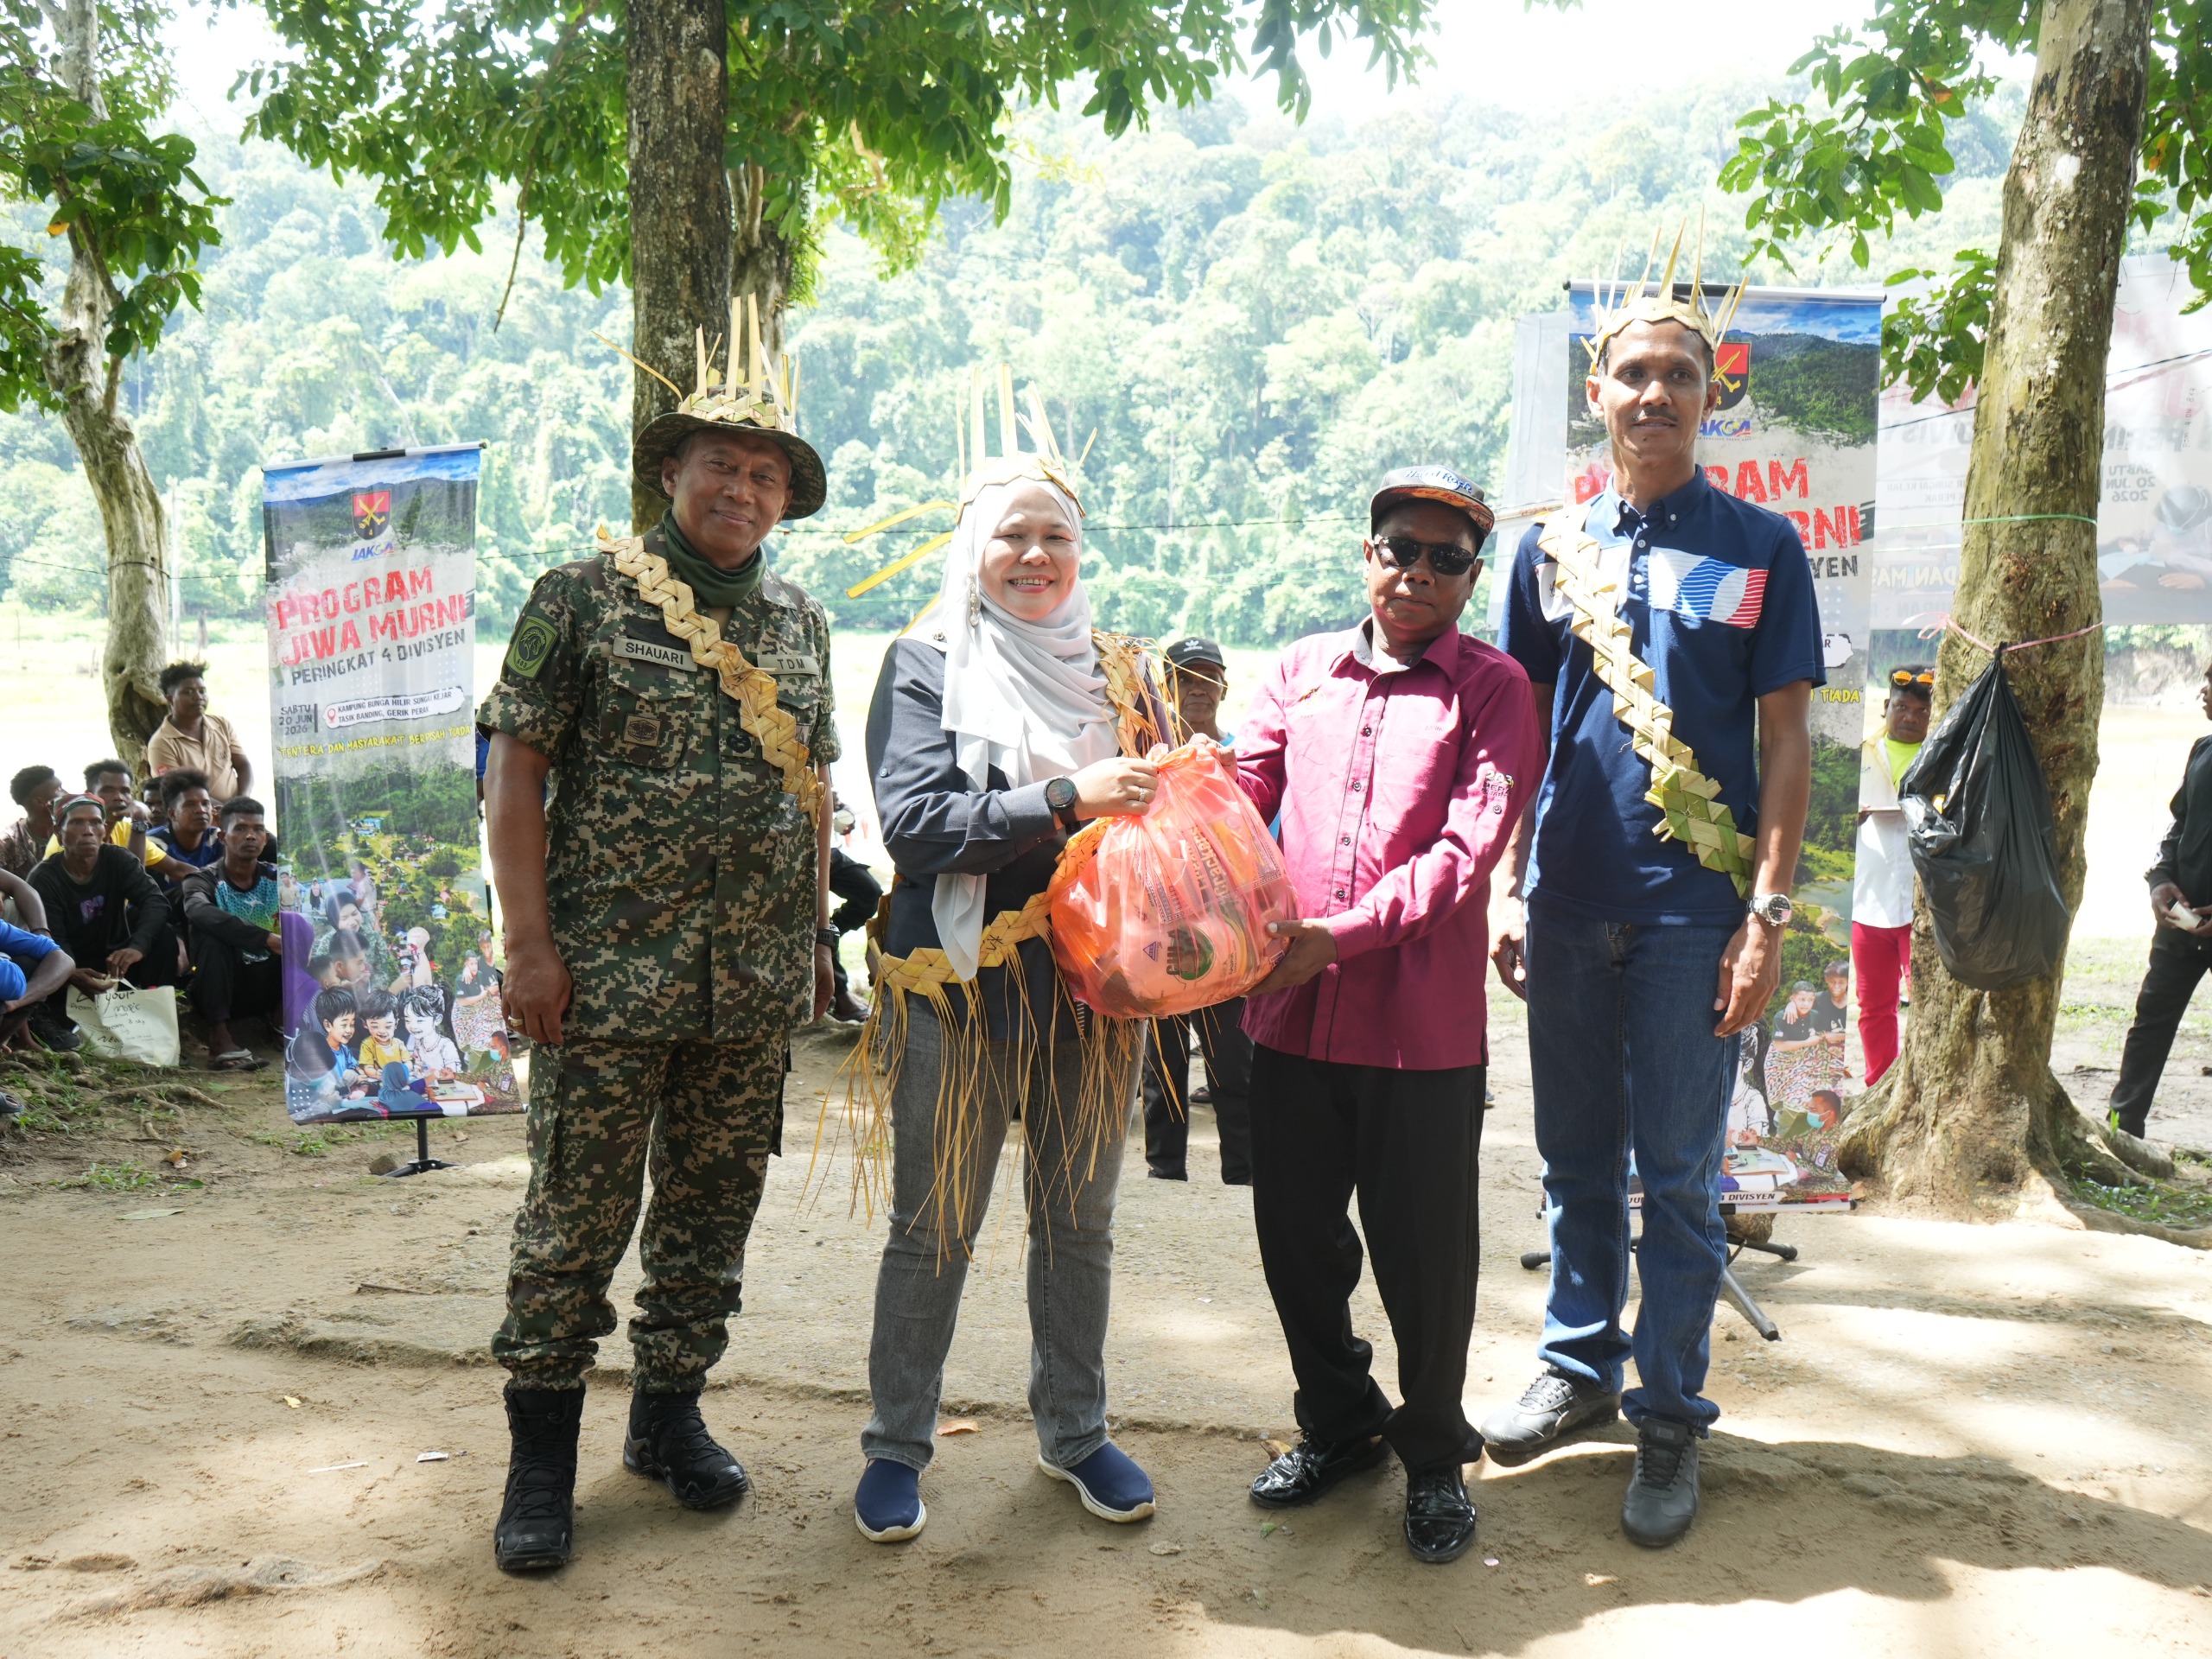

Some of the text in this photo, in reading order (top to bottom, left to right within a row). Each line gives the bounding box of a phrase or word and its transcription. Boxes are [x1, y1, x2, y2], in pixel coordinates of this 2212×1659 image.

[1699, 419, 1751, 437] AKOA
[276, 565, 434, 631] PROGRAM
[282, 594, 467, 667] JIWA MURNI
[291, 628, 466, 686] PERINGKAT 4 DIVISYEN
[625, 642, 683, 665] SHAUARI
[777, 658, 806, 670] TDM
[281, 703, 312, 716] SABTU
[338, 702, 366, 714] KAMPUNG
[367, 698, 390, 708] BUNGA
[391, 697, 411, 708] HILIR
[433, 691, 452, 702] KEJAR
[278, 715, 313, 727] 20 JUN
[338, 715, 355, 724] TASIK
[387, 708, 410, 717] GERIK
[284, 724, 308, 736] 2026
[327, 743, 346, 754] DAN
[346, 735, 404, 751] MASYARAKAT
